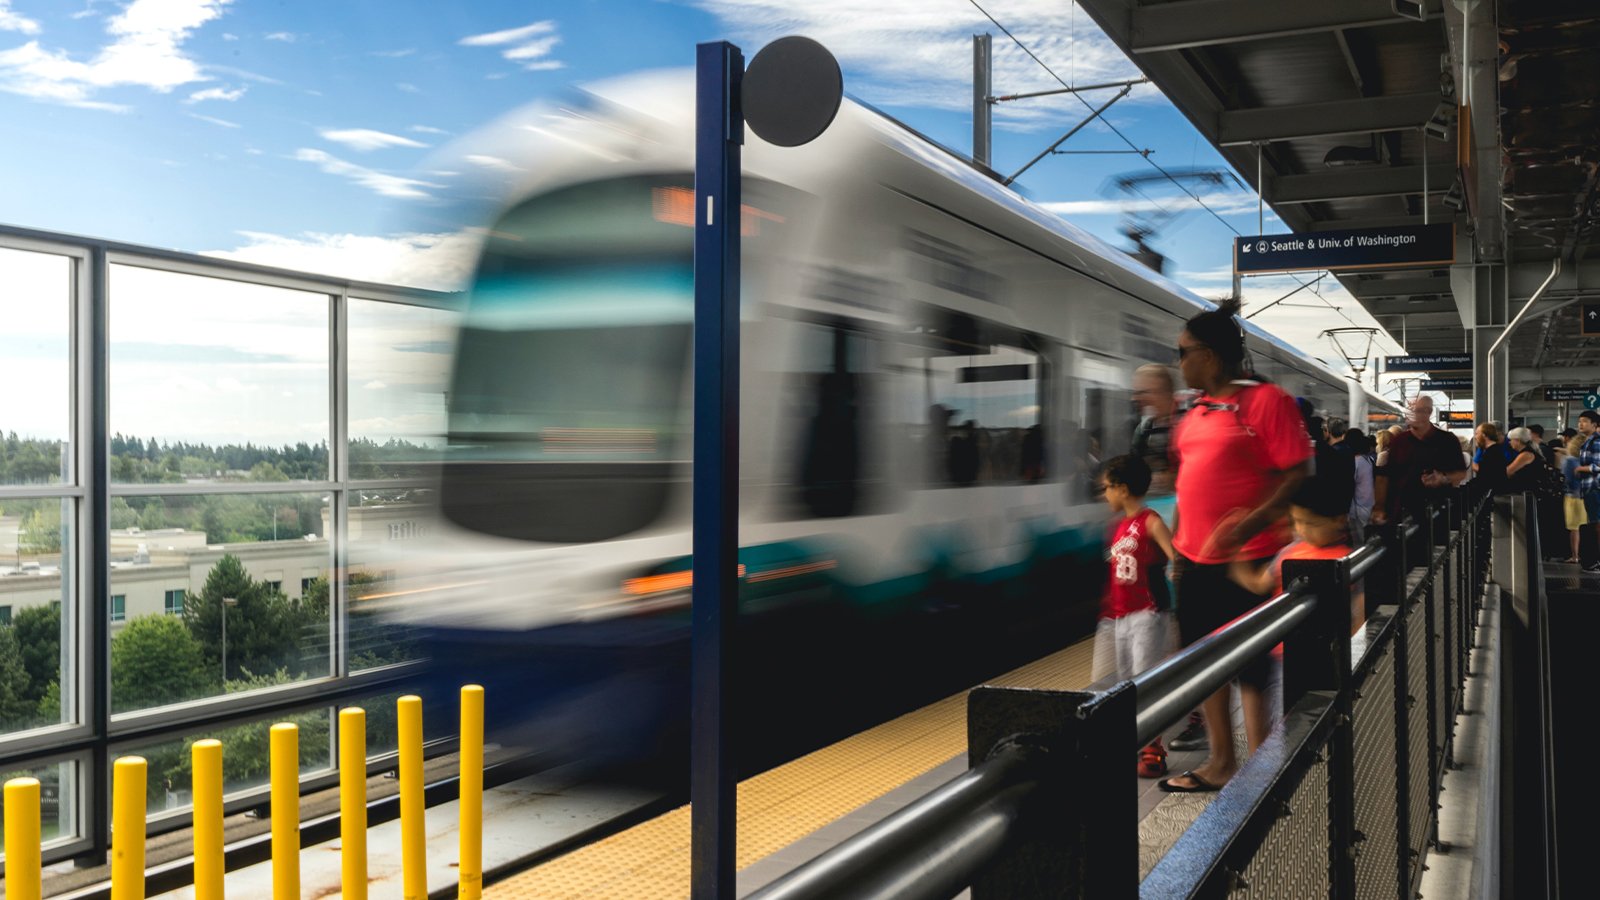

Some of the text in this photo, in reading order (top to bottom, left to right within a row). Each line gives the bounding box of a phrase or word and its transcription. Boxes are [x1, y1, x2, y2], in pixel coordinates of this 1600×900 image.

[1271, 235, 1416, 252] Seattle & Univ. of Washington
